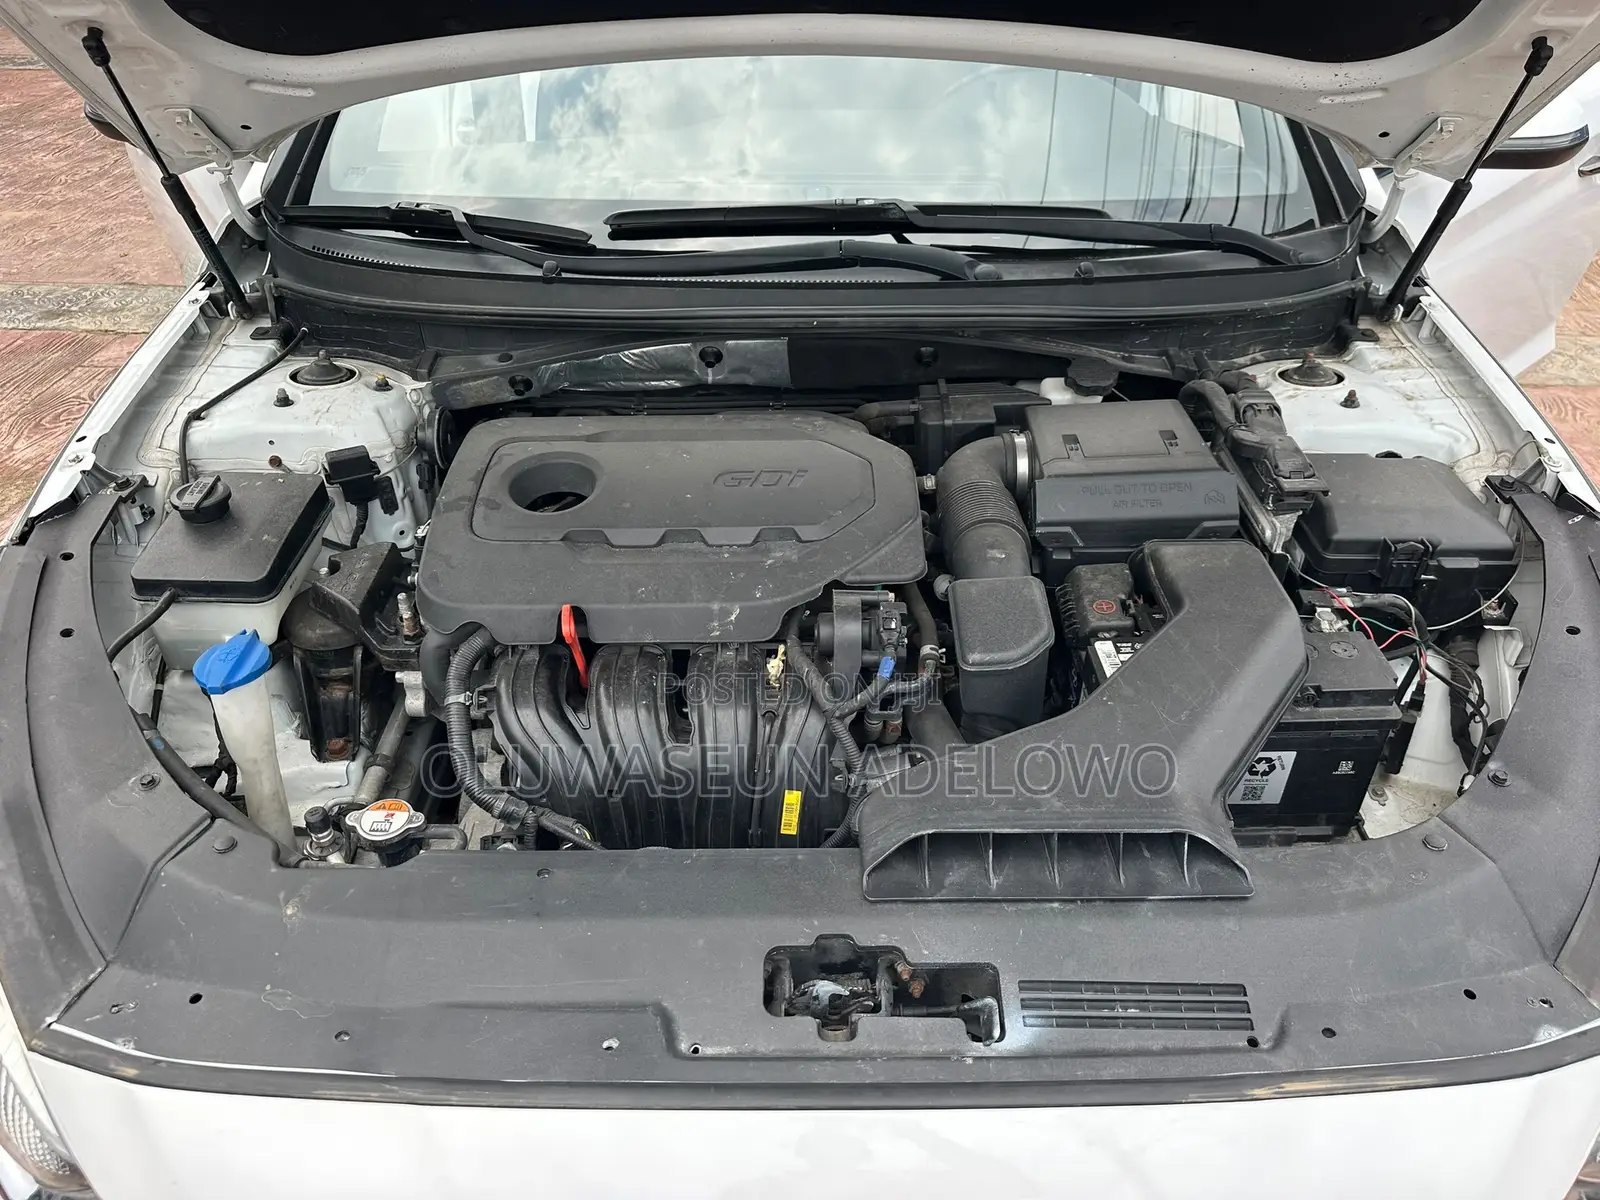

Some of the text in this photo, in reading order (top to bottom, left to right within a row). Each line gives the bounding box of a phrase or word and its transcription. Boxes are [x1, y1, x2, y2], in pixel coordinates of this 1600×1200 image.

[1080, 481, 1193, 496] PULL OUT TO OPEN
[1112, 498, 1163, 509] AIR FILTER
